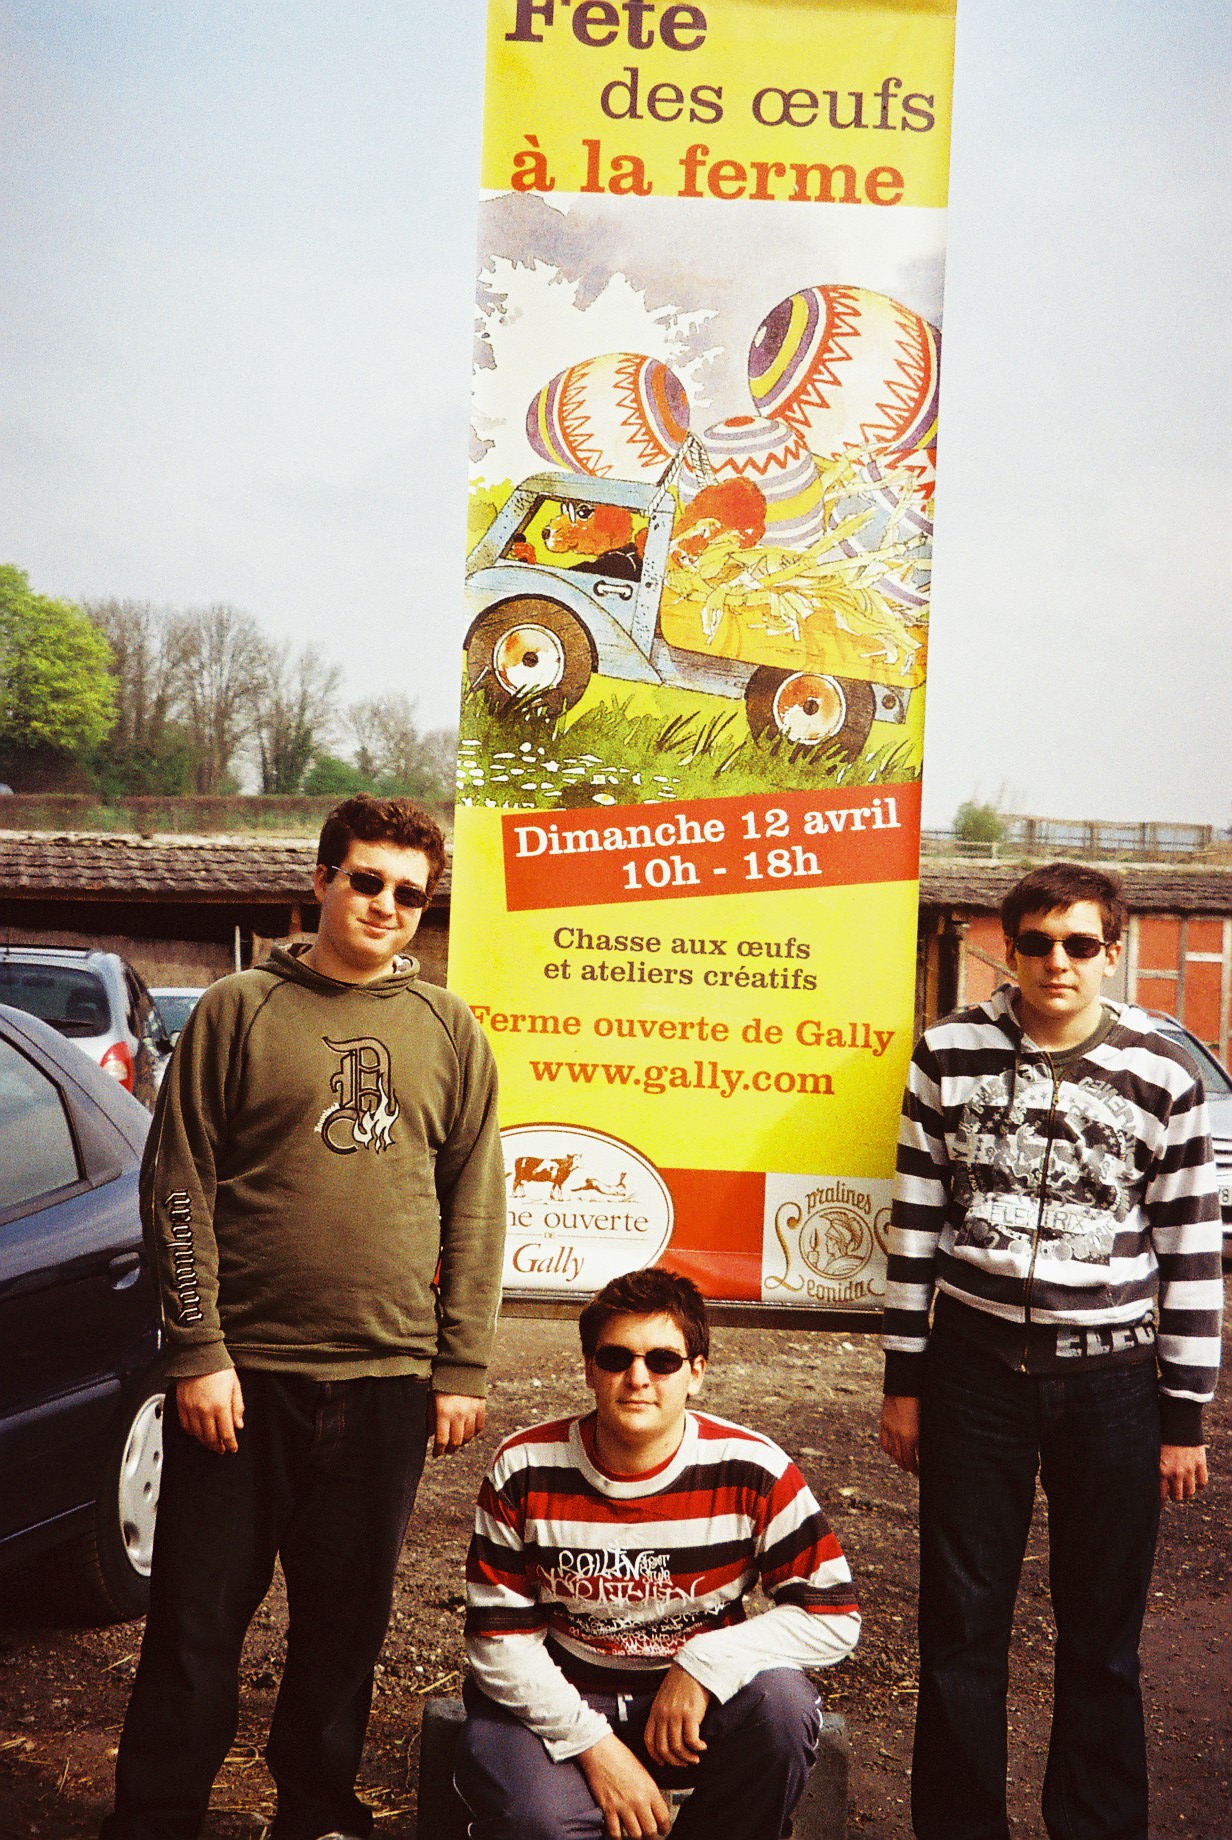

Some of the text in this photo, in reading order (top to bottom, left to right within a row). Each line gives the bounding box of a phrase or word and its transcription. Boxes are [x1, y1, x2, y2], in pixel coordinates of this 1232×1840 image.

[600, 67, 935, 132] des œufs
[510, 135, 905, 207] à la ferme
[514, 797, 901, 859] Dimanche 12 avril
[622, 855, 700, 890] 10h
[743, 845, 823, 881] 18h
[553, 927, 811, 961] Chasse aux œufs
[543, 960, 818, 991] et ateliers créatifs
[470, 1005, 895, 1056] Ferme ouverte de Gally
[530, 1058, 835, 1098] www.gally.com
[805, 1180, 872, 1215] pralines
[543, 1211, 649, 1232] ouverte
[512, 1243, 585, 1282] Gally
